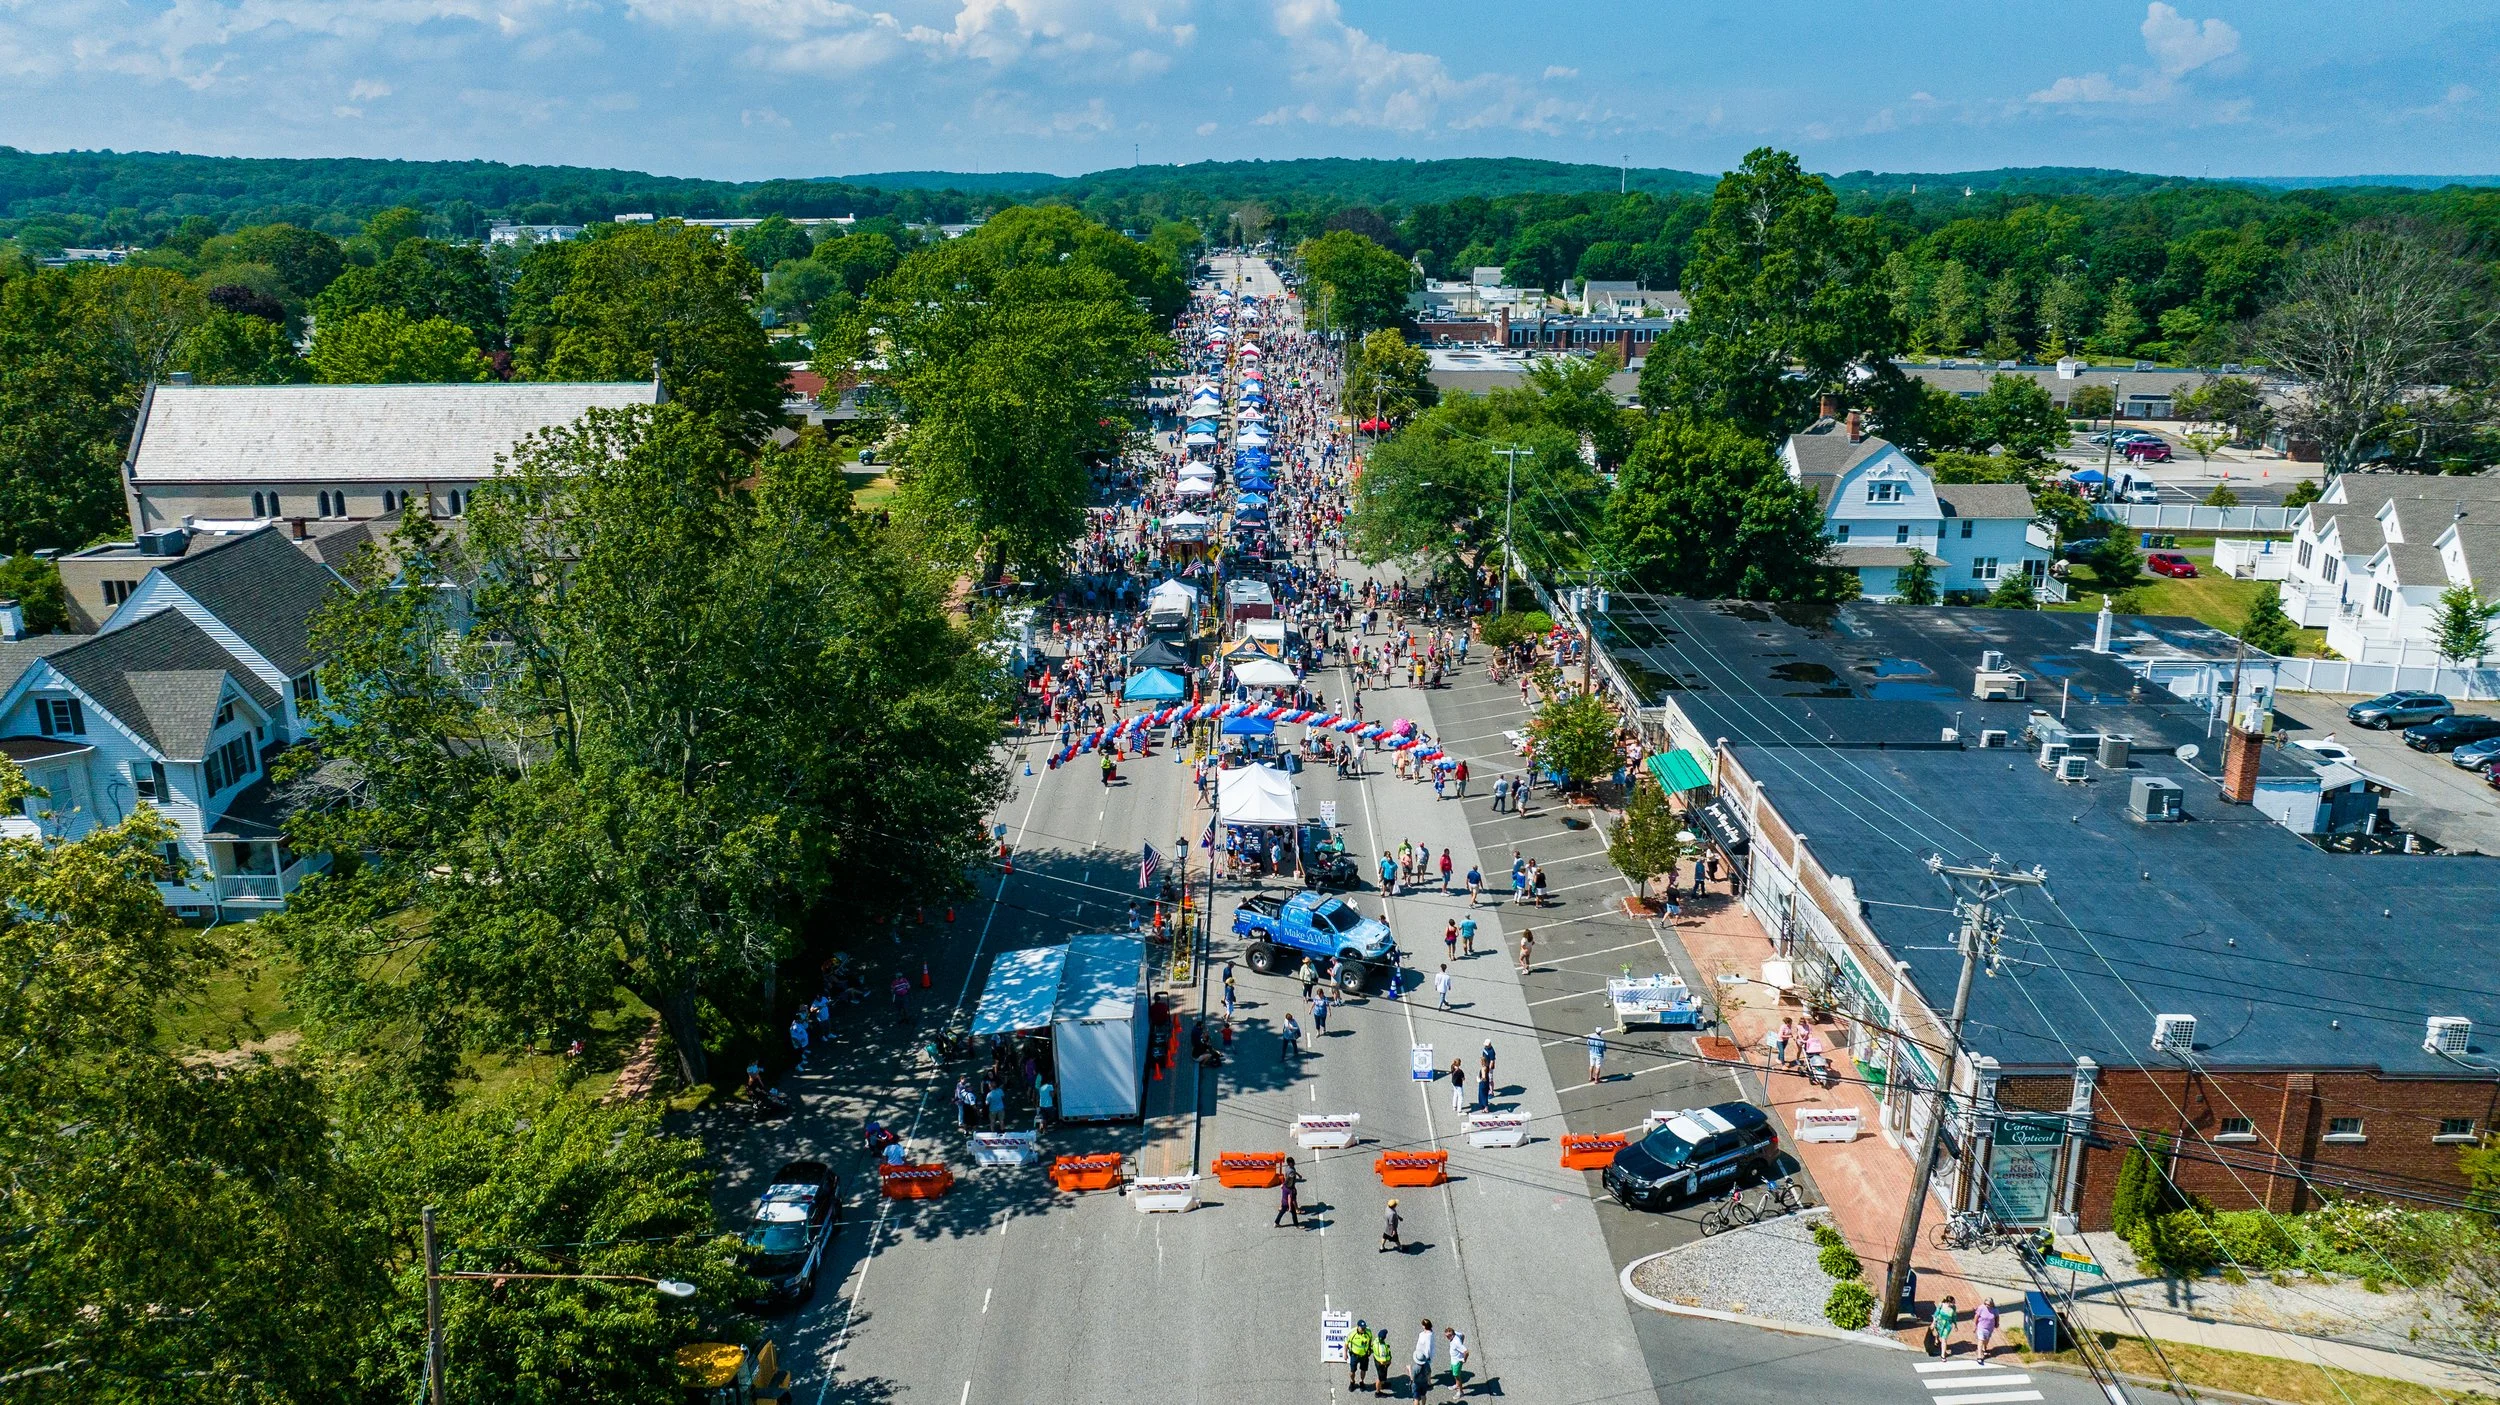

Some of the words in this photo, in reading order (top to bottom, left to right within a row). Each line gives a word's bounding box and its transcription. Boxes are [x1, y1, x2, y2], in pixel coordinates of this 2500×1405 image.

[1284, 927, 1305, 939] Make
[2012, 1130, 2055, 1144] Optical
[1700, 1165, 1737, 1184] POLICE
[2010, 1164, 2034, 1172] Kids
[2049, 1257, 2093, 1273] SHEFFIELD
